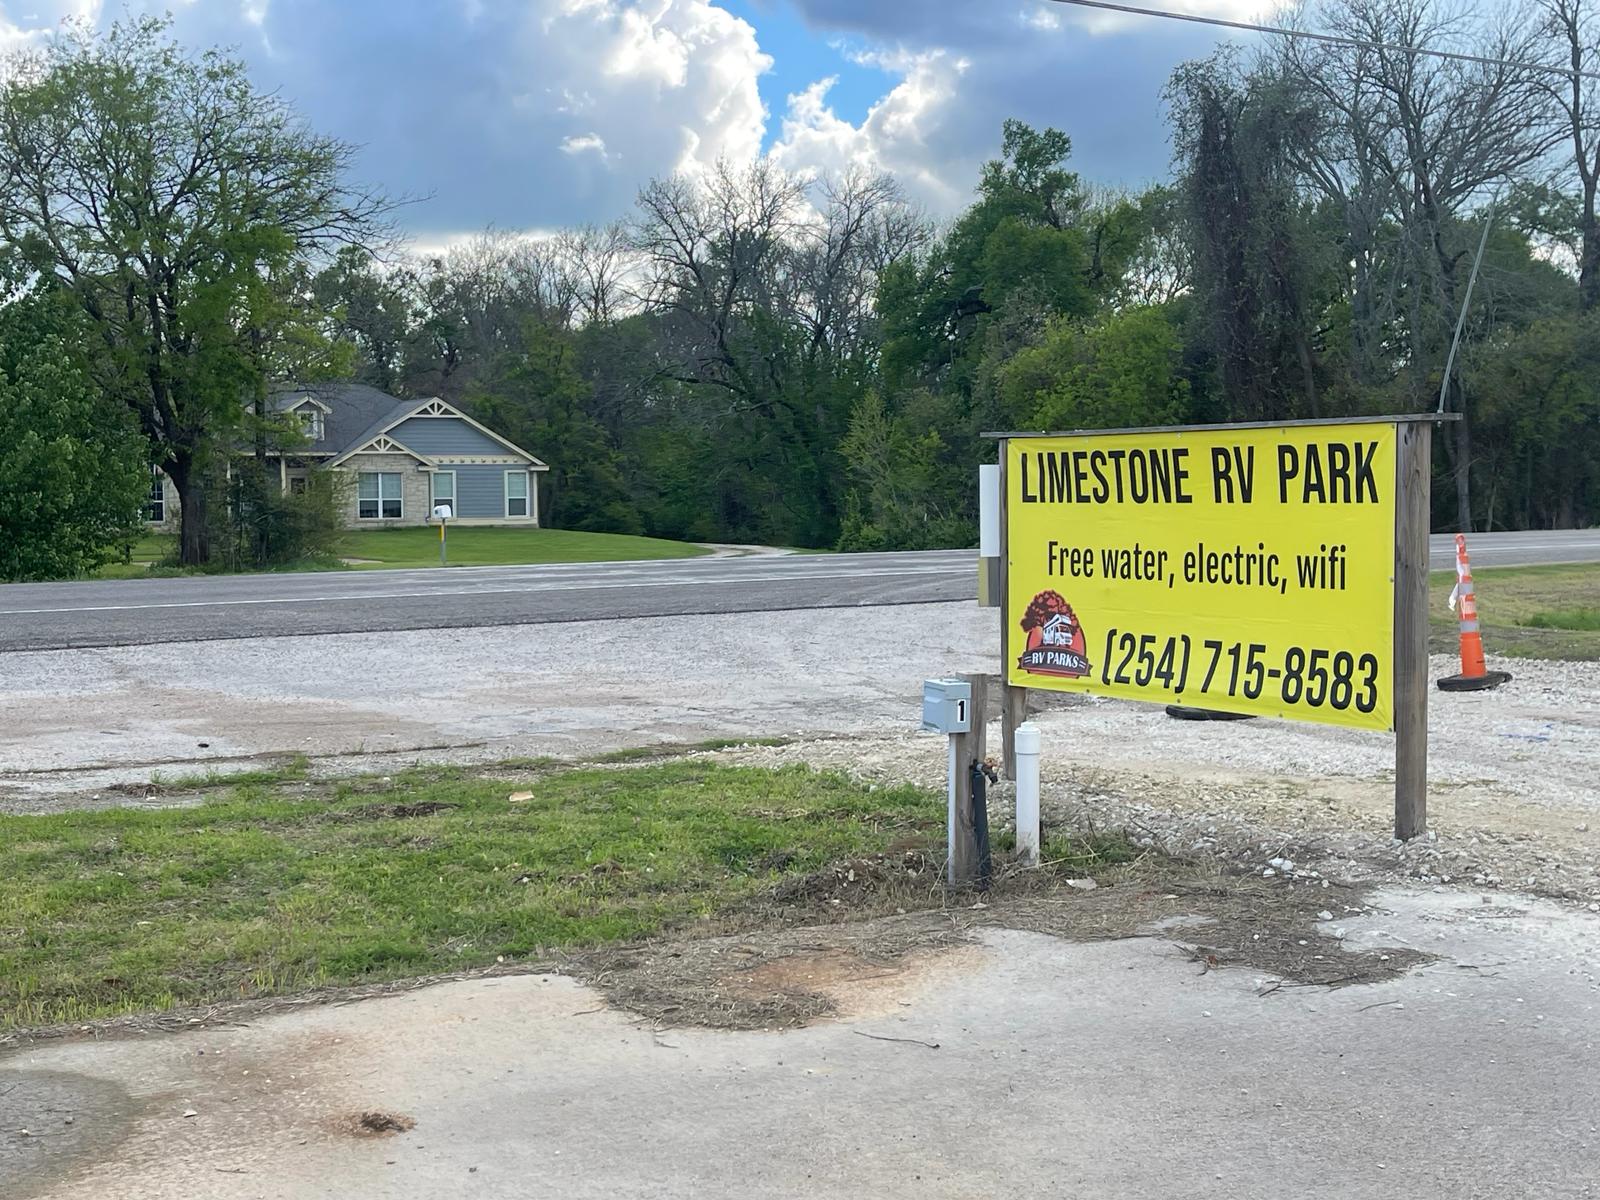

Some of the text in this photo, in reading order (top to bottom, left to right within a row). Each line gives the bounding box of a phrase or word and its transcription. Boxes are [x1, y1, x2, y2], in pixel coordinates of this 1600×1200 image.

[1021, 441, 1379, 504] LIMESTONE RV PARK
[1048, 541, 1346, 594] Free water, electric, wifi
[1032, 652, 1079, 668] RV PARKS
[1102, 628, 1378, 713] (254) 715-8583
[957, 700, 965, 721] 1
